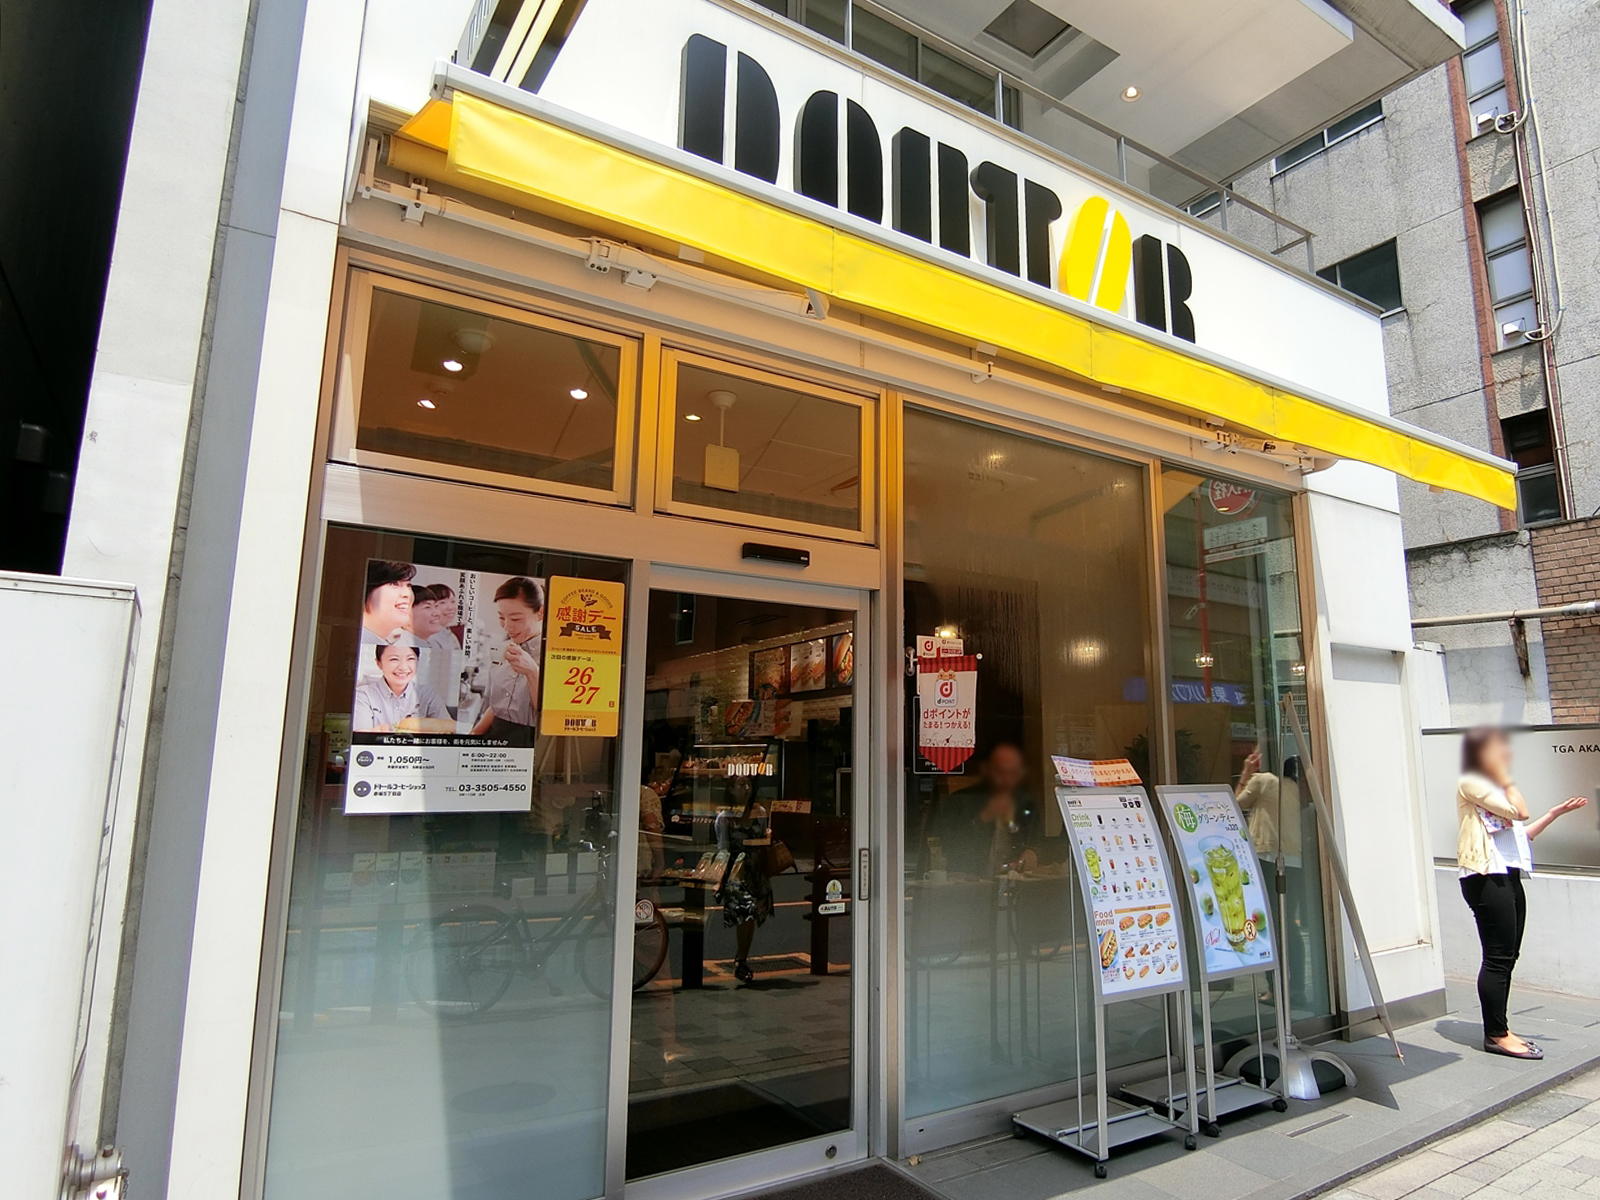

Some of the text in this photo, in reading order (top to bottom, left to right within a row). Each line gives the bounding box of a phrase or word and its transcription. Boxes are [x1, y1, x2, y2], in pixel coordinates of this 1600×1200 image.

[678, 33, 1195, 344] DOUTOR
[556, 606, 616, 623] 感謝デー
[575, 625, 597, 633] SALE
[564, 667, 595, 686] 26
[570, 685, 601, 705] 27
[923, 708, 971, 719] dポイントが
[1552, 744, 1600, 753] TGA AKA
[728, 762, 773, 776] DOUTOR
[459, 784, 527, 792] 03-3505-4550
[1071, 813, 1091, 821] Drink
[1176, 806, 1196, 829] 梅
[1198, 813, 1235, 824] グリーンティー
[1094, 909, 1114, 919] Food
[1095, 918, 1115, 926] menu
